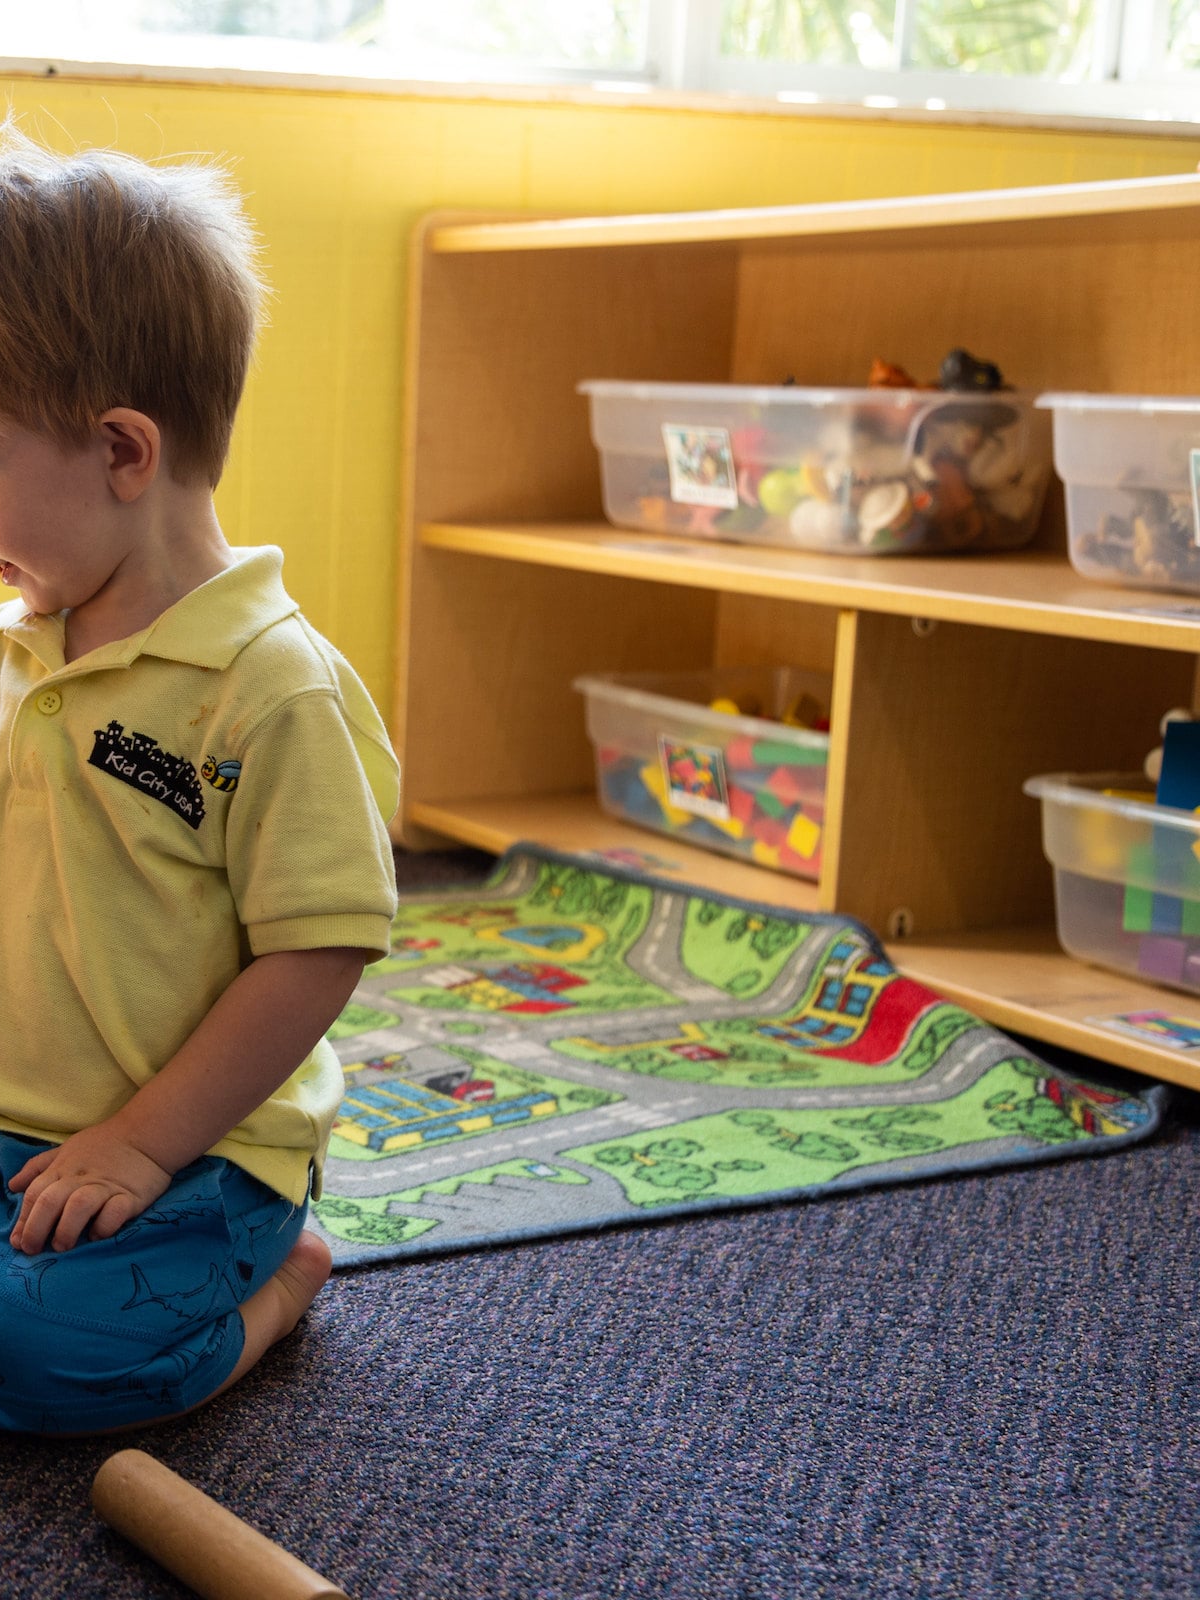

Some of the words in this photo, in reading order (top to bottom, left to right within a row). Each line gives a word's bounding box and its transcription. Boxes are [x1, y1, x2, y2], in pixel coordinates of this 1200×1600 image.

[105, 751, 137, 777] Kid
[138, 770, 173, 799] City
[174, 792, 193, 816] USA
